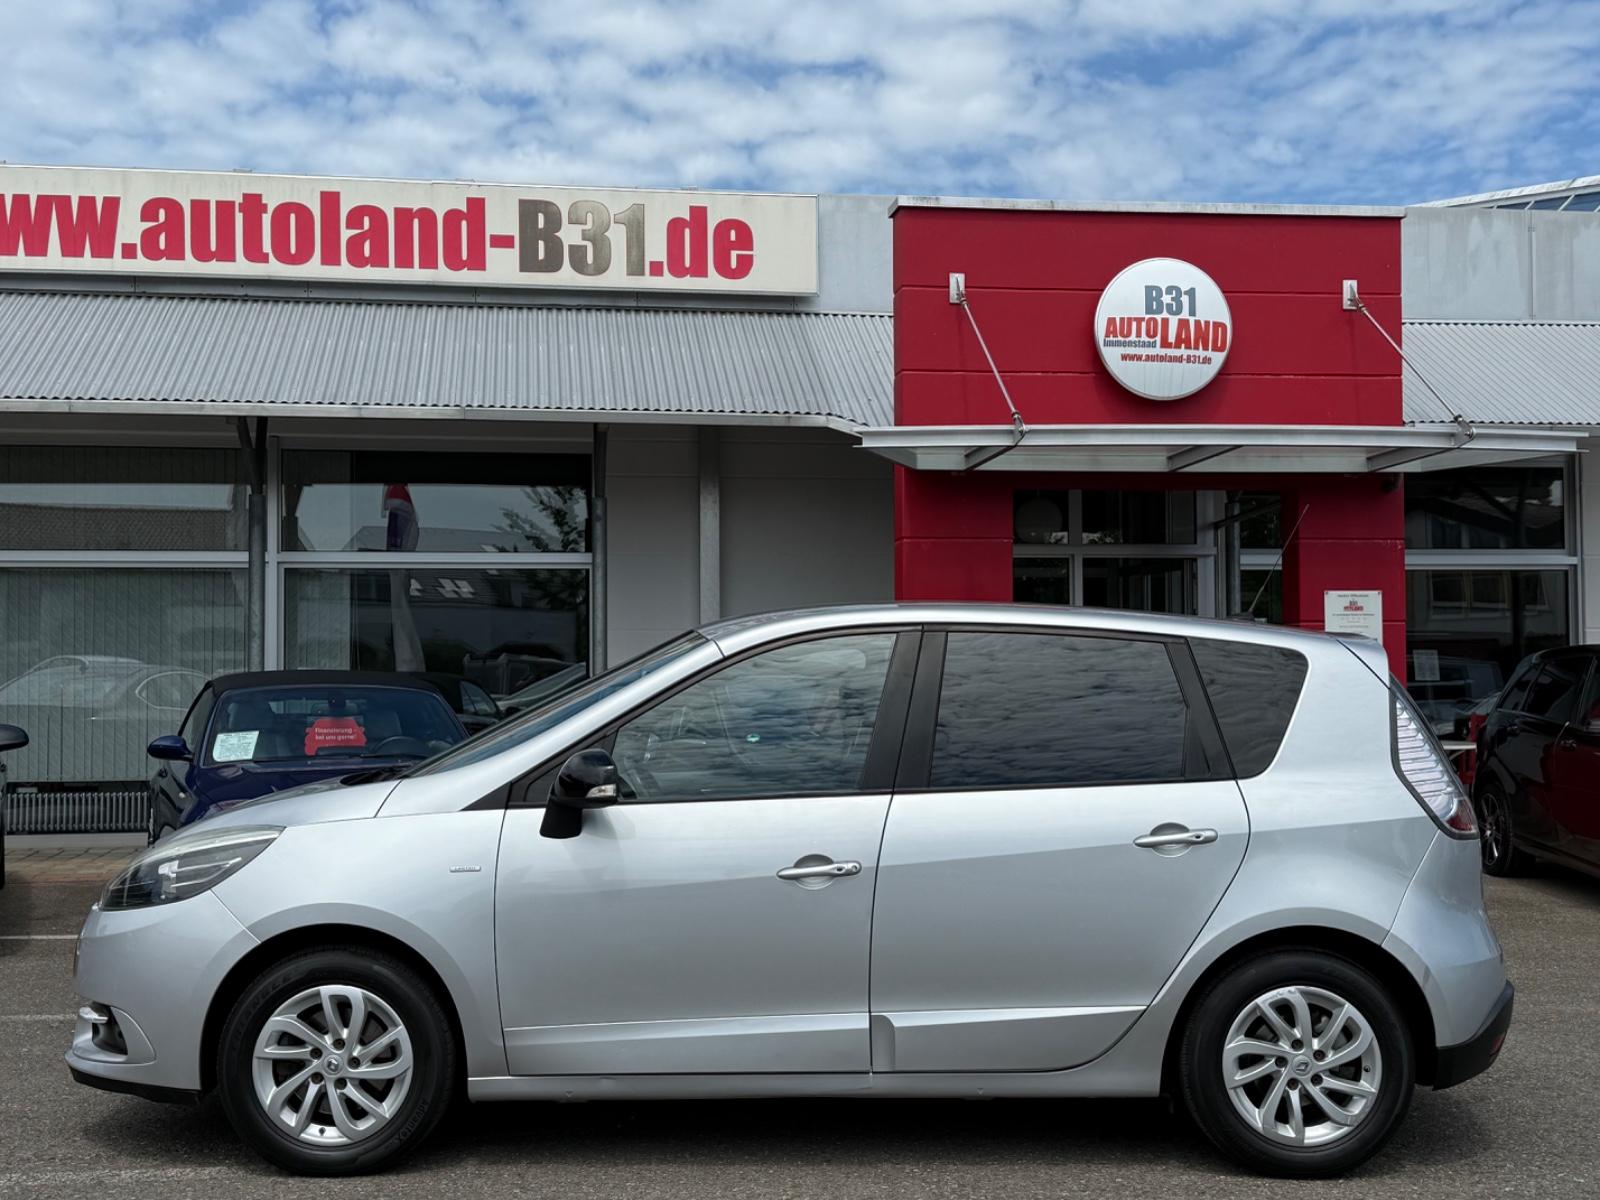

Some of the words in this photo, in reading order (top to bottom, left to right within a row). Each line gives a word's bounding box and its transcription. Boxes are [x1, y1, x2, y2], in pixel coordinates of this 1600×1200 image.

[1144, 285, 1197, 317] B31
[1103, 338, 1157, 349] Immenstaad
[1120, 352, 1212, 365] www.autoland-B31.de
